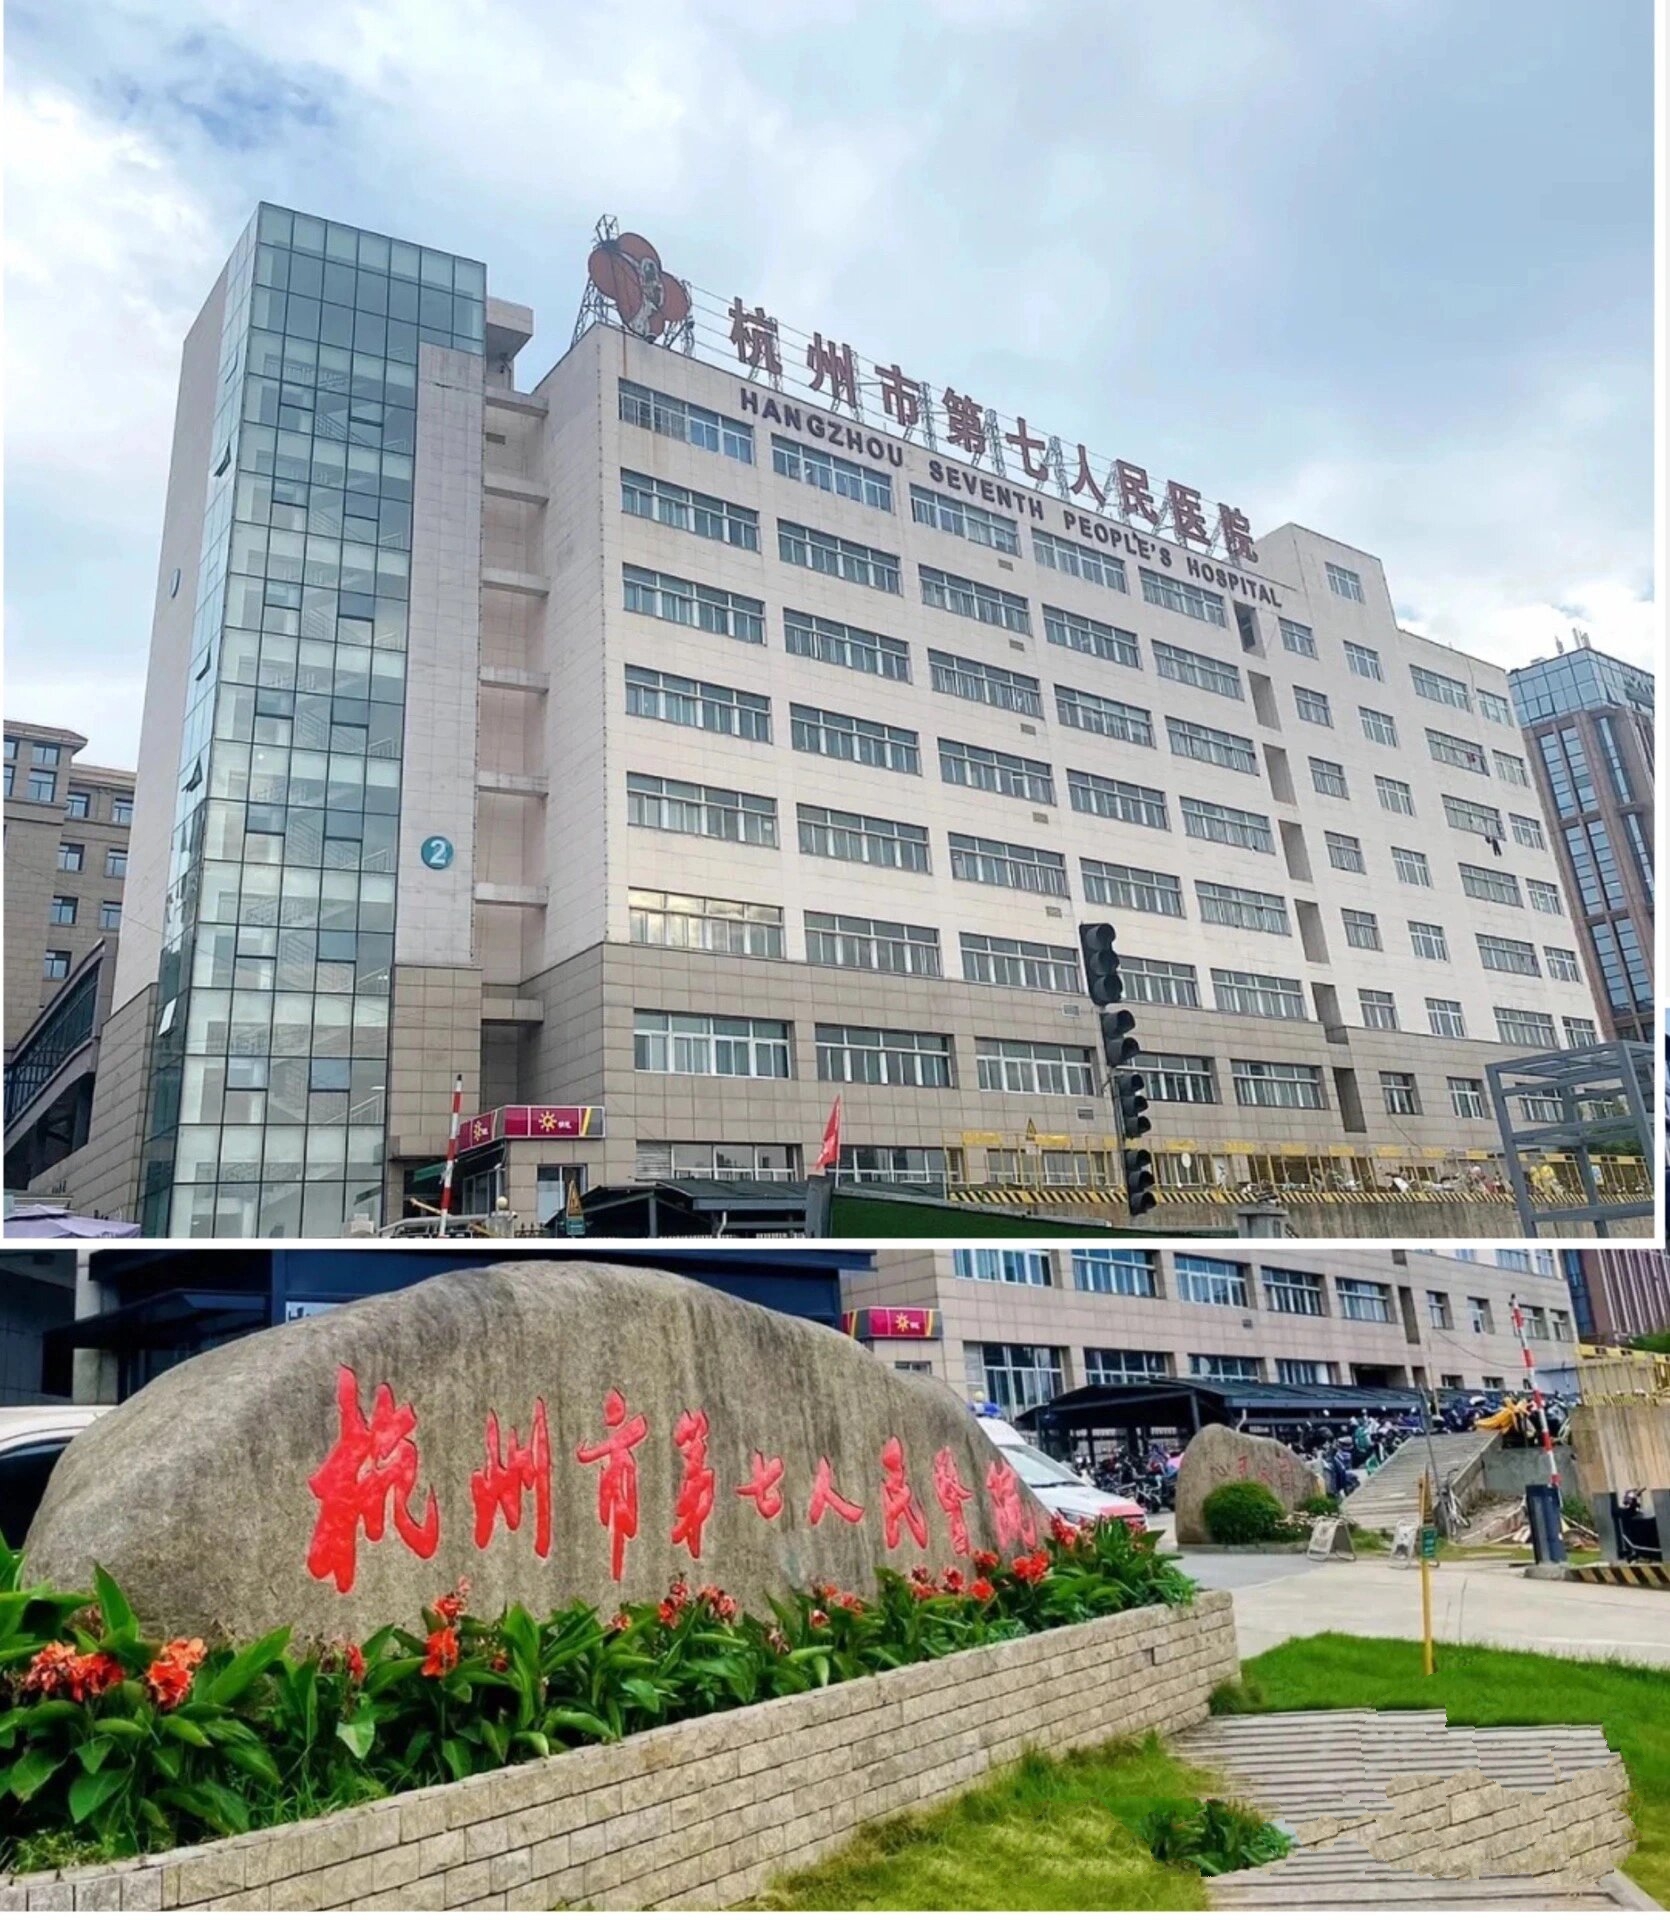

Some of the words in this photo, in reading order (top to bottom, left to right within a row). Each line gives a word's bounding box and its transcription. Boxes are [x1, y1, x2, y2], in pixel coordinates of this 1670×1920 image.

[728, 296, 1259, 564] 杭州市第七人民医院
[740, 387, 904, 467] HANGZHOU
[928, 459, 1044, 521] SEVENTH
[1063, 509, 1172, 568] PEOPLE'S
[1186, 556, 1282, 608] HOSPITAL
[429, 840, 447, 864] 2
